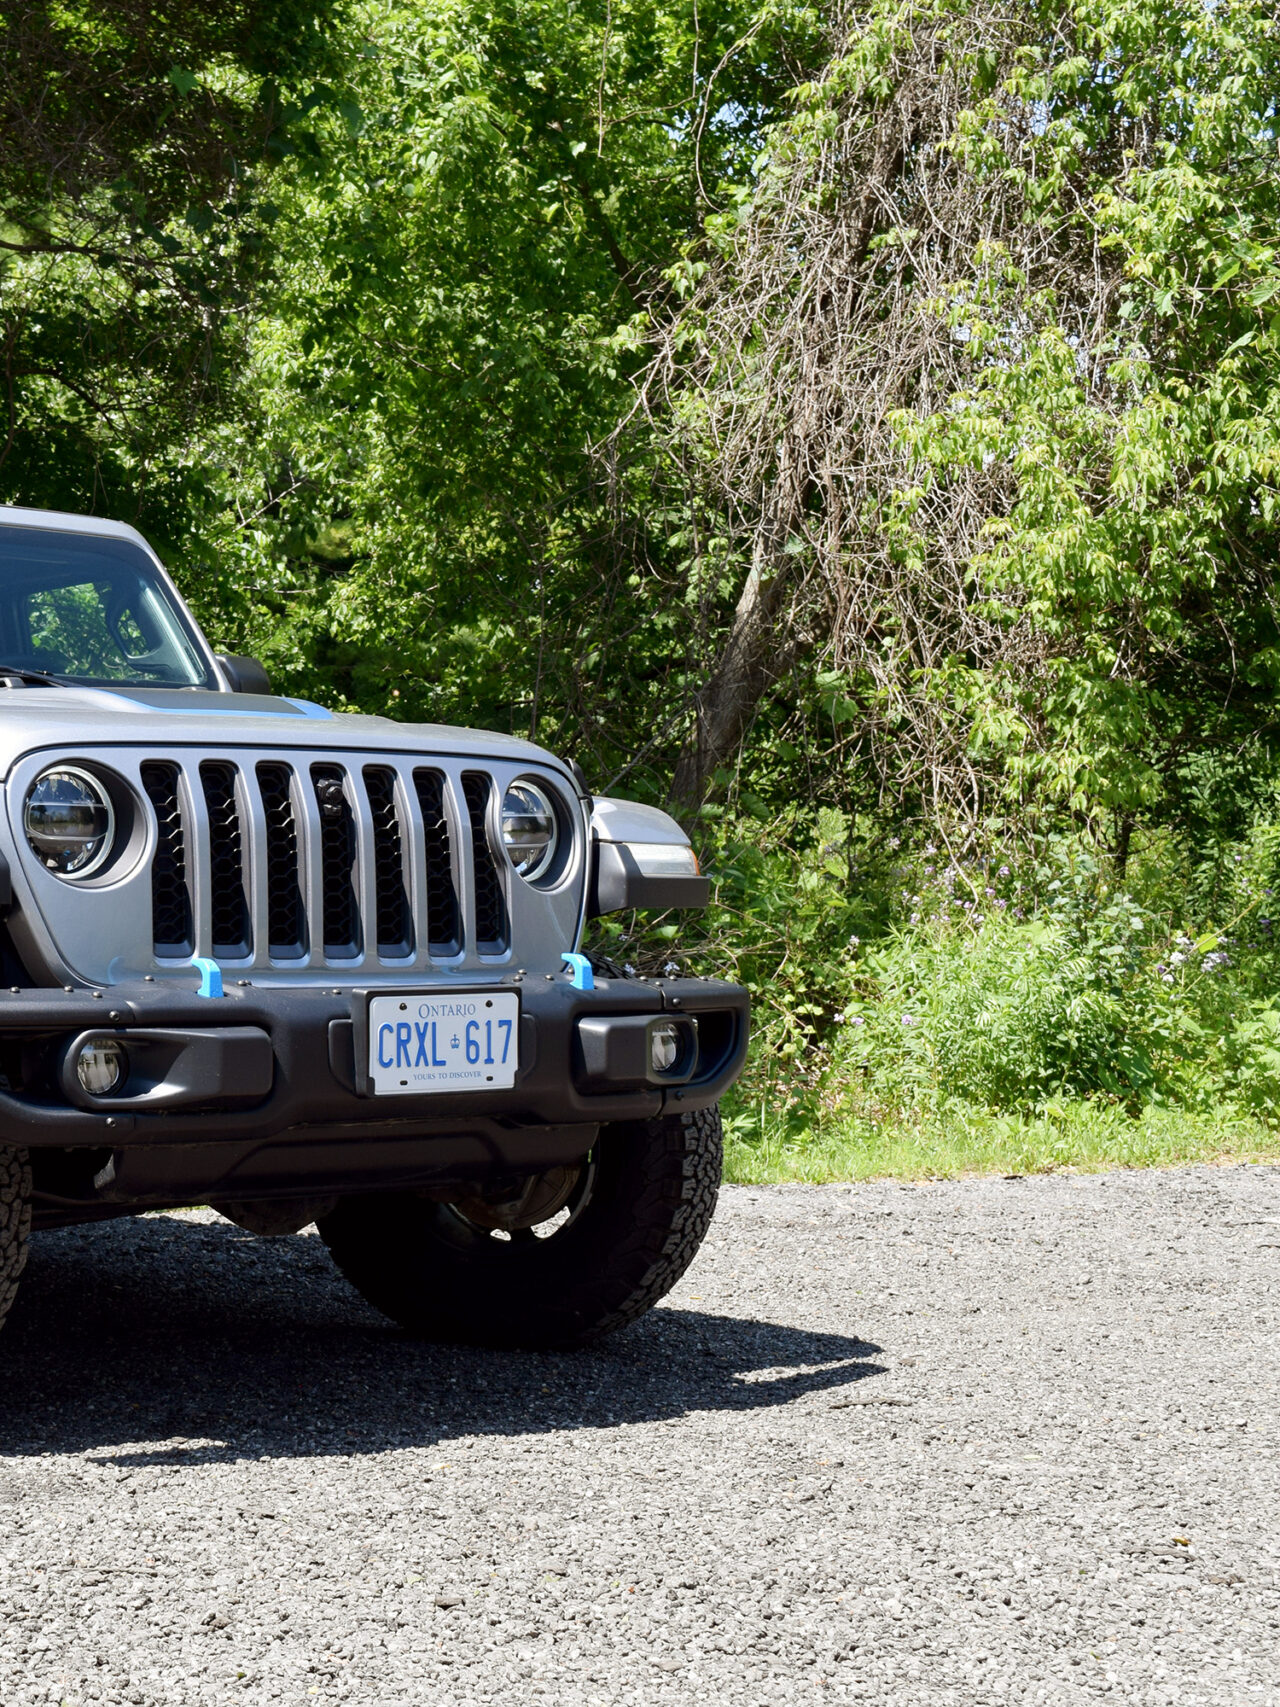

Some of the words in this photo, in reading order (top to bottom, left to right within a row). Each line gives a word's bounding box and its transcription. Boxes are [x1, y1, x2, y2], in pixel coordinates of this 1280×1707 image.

[418, 1003, 476, 1019] ONTARIO
[378, 1021, 447, 1068] CRXL
[465, 1019, 513, 1065] 617
[413, 1072, 436, 1081] YOURS
[438, 1071, 448, 1080] TO
[449, 1070, 482, 1079] DISCOVER
